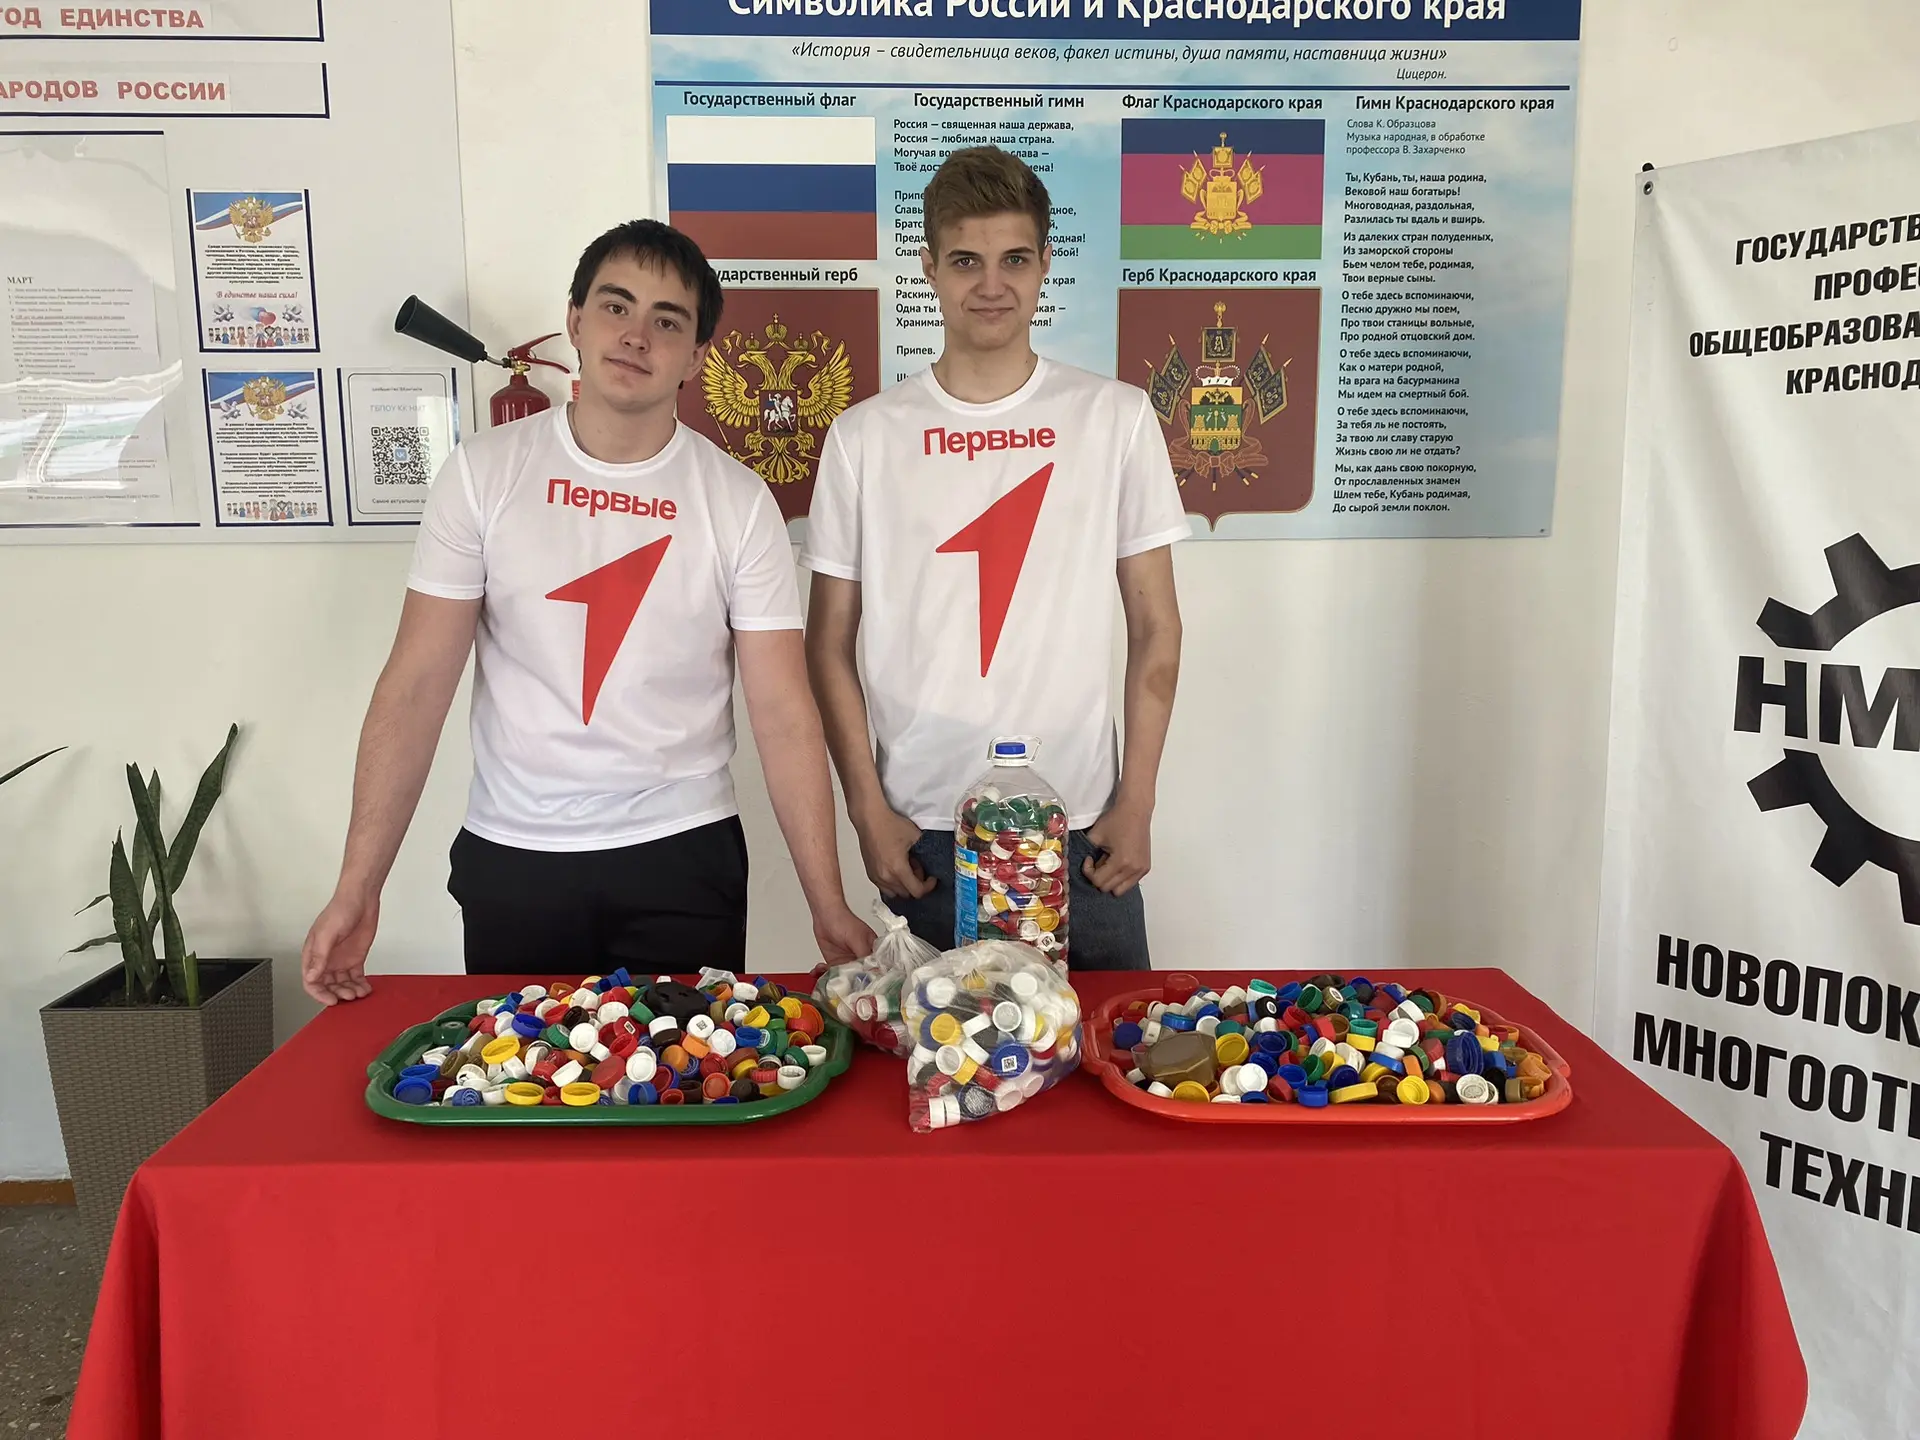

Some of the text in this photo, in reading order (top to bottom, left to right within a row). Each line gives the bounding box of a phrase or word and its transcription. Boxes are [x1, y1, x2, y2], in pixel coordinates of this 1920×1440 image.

[0, 7, 204, 30] ОД ЕДИНСТВА
[728, 0, 1505, 28] Символика России и Краснодарского края
[792, 42, 1447, 63] «История свидетельница веков, факел истины, душа памяти, наставница жизни»
[1396, 68, 1447, 82] Цицерон.
[118, 81, 226, 101] РОССИИ
[684, 91, 856, 110] Государственный флаг
[914, 92, 1084, 110] Государственный гимн
[1122, 94, 1322, 112] Флаг Краснодарского края
[1356, 96, 1554, 113] Гимн Краснодарского края
[894, 118, 1074, 132] Россия священная наша держава,
[1346, 118, 1436, 130] Слова К. Образцова
[894, 133, 1054, 146] Россия любимая наша страна.
[1346, 132, 1381, 143] Музыка
[1383, 133, 1429, 143] народная,
[1438, 132, 1485, 143] обработке
[894, 148, 936, 160] Могучая
[1346, 144, 1466, 156] профессора В. Захарченко
[894, 162, 917, 172] Твоё
[1345, 172, 1487, 184] Ты, Кубань, ты, наша родина,
[894, 190, 924, 202] Припе
[1345, 186, 1460, 198] Вековой наш богатырь!
[894, 204, 924, 214] Славь
[1344, 200, 1474, 212] Многоводная, раздольная,
[895, 218, 924, 230] Братс
[1344, 214, 1485, 226] Разлилась ты вдаль и вширь.
[895, 232, 1086, 244] Предк родная!
[1344, 232, 1494, 244] Из далеких стран полуденных,
[1051, 247, 1078, 257] обой!
[1343, 245, 1454, 257] Из заморской стороны
[1343, 259, 1474, 271] Бьем челом тебе, родимая,
[7, 276, 34, 284] МАРТ
[716, 267, 858, 284] дарственный герб
[895, 275, 908, 285] От
[1052, 277, 1076, 287] края
[1123, 268, 1316, 285] Герб Краснодарского края
[1342, 273, 1365, 282] Твои
[1367, 275, 1404, 284] верные
[1814, 262, 1920, 301] ПРОФЕ
[279, 291, 298, 299] сила!
[896, 289, 938, 301] Раскину
[1341, 290, 1474, 301] О тебе здесь вспоминаючи,
[895, 303, 936, 314] Одна ты
[1341, 304, 1460, 316] Песню дружно мы поем,
[1340, 318, 1474, 330] Про твои станицы вольные,
[1340, 331, 1475, 343] Про родной отцовский дом.
[1689, 310, 1920, 358] ОБЩЕОБРАЗОВА
[896, 345, 936, 357] Припев.
[1786, 359, 1920, 395] КРАСНОД
[923, 422, 1056, 462] Первые
[1334, 463, 1354, 474] Мы,
[1374, 465, 1398, 474] дань
[1399, 464, 1424, 472] свою
[1426, 464, 1476, 474] покорную,
[1334, 476, 1347, 486] От
[1348, 478, 1424, 488] прославленных
[546, 478, 678, 521] Первые
[1333, 489, 1470, 501] Шлем тебе, Кубань родимая,
[1332, 503, 1450, 514] До сырой земли поклон.
[1656, 933, 1920, 1048] НОВОПОК
